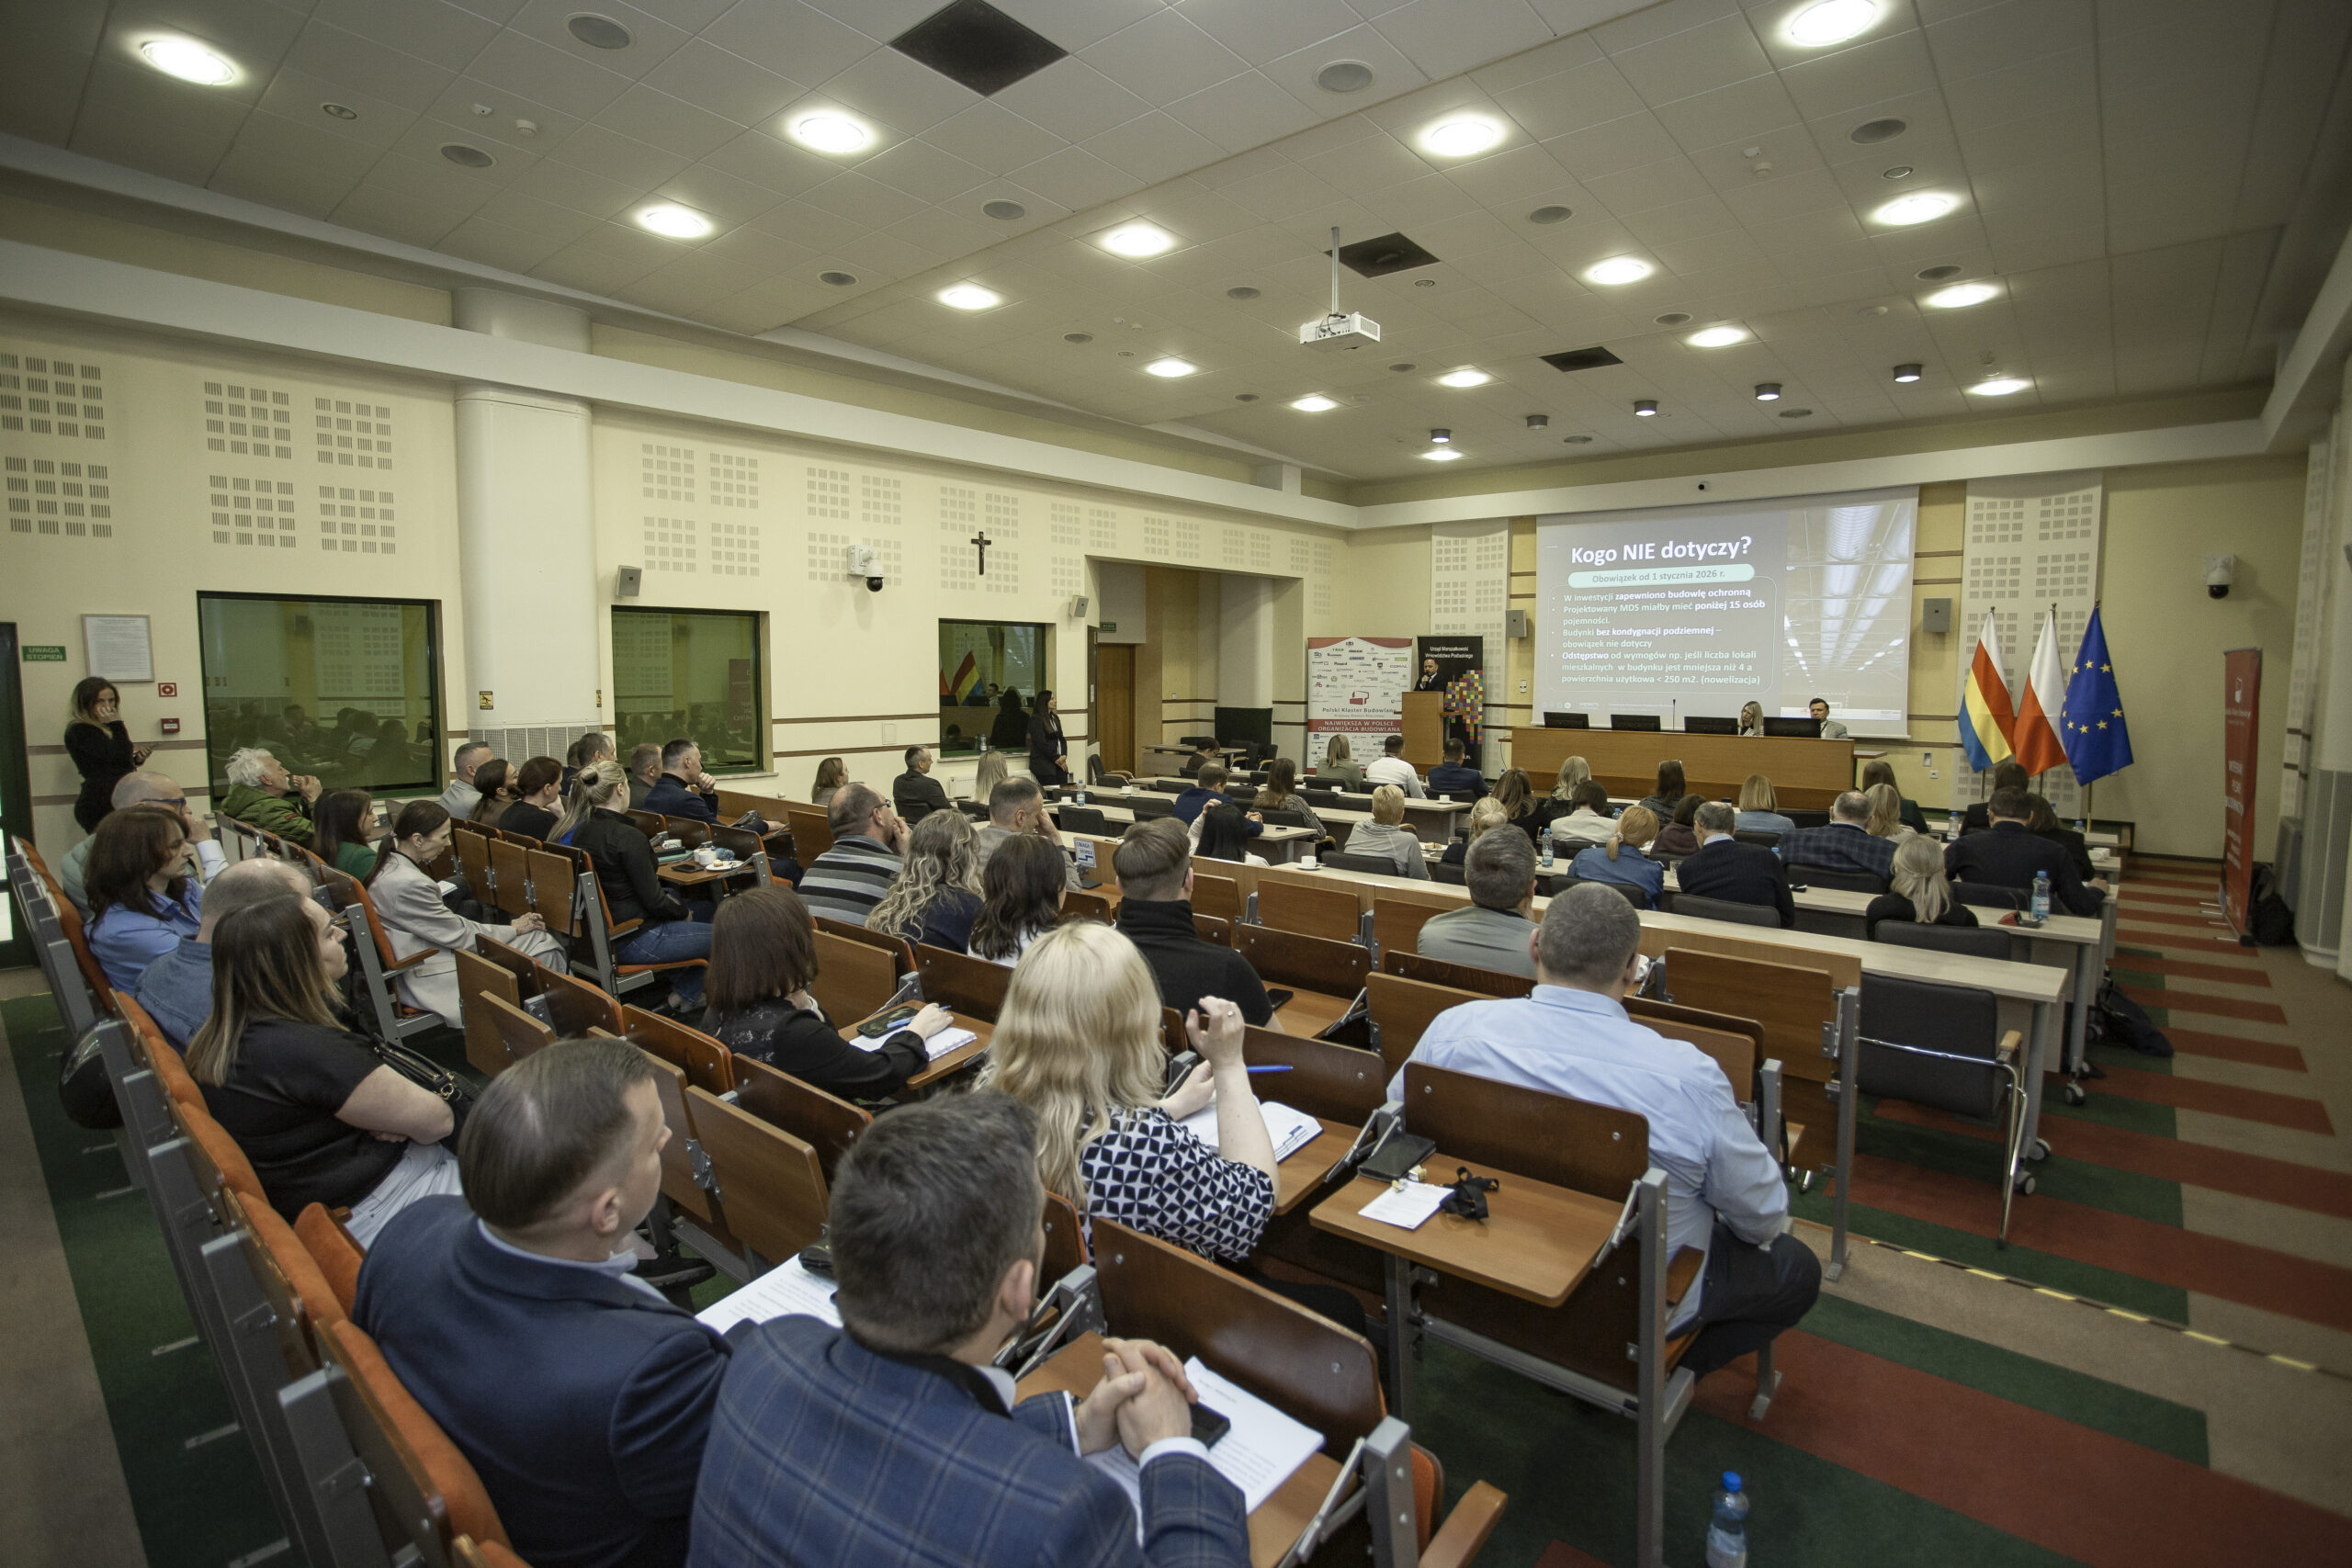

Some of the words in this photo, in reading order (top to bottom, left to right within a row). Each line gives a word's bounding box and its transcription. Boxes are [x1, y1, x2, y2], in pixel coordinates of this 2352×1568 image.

[1571, 547, 1617, 566] Kogo
[1623, 543, 1656, 560] NIE
[1661, 536, 1752, 560] dotyczy?
[1593, 573, 1637, 583] Obowiązek
[1659, 571, 1693, 581] stycznia
[1574, 593, 1613, 602] inwestycji
[1615, 592, 1666, 601] zapewniono
[1668, 590, 1706, 599] budowlę
[1708, 589, 1751, 597] ochronną
[1564, 606, 1618, 614] Projektowany
[1641, 603, 1670, 612] miałby
[1695, 601, 1727, 612] poniżej
[1743, 600, 1765, 608] osób
[1563, 617, 1610, 626] pojemności.
[1563, 629, 1594, 637] Budynki
[1612, 627, 1661, 637] kondygnacji
[1663, 626, 1714, 636] podziemnej
[1562, 640, 1604, 649] obowiązek
[1620, 640, 1652, 648] dotyczy
[1562, 652, 1609, 661] Odstępstwo
[1623, 651, 1666, 660] wymogów
[1684, 651, 1702, 660] jeśli
[1562, 663, 1613, 672] mieszkalnych
[1627, 663, 1663, 672] budynku
[1665, 664, 1680, 672] jest
[1683, 664, 1721, 672] mniejsza
[1616, 675, 1654, 683] użytkowa
[1701, 675, 1760, 685] (nowelizacja)
